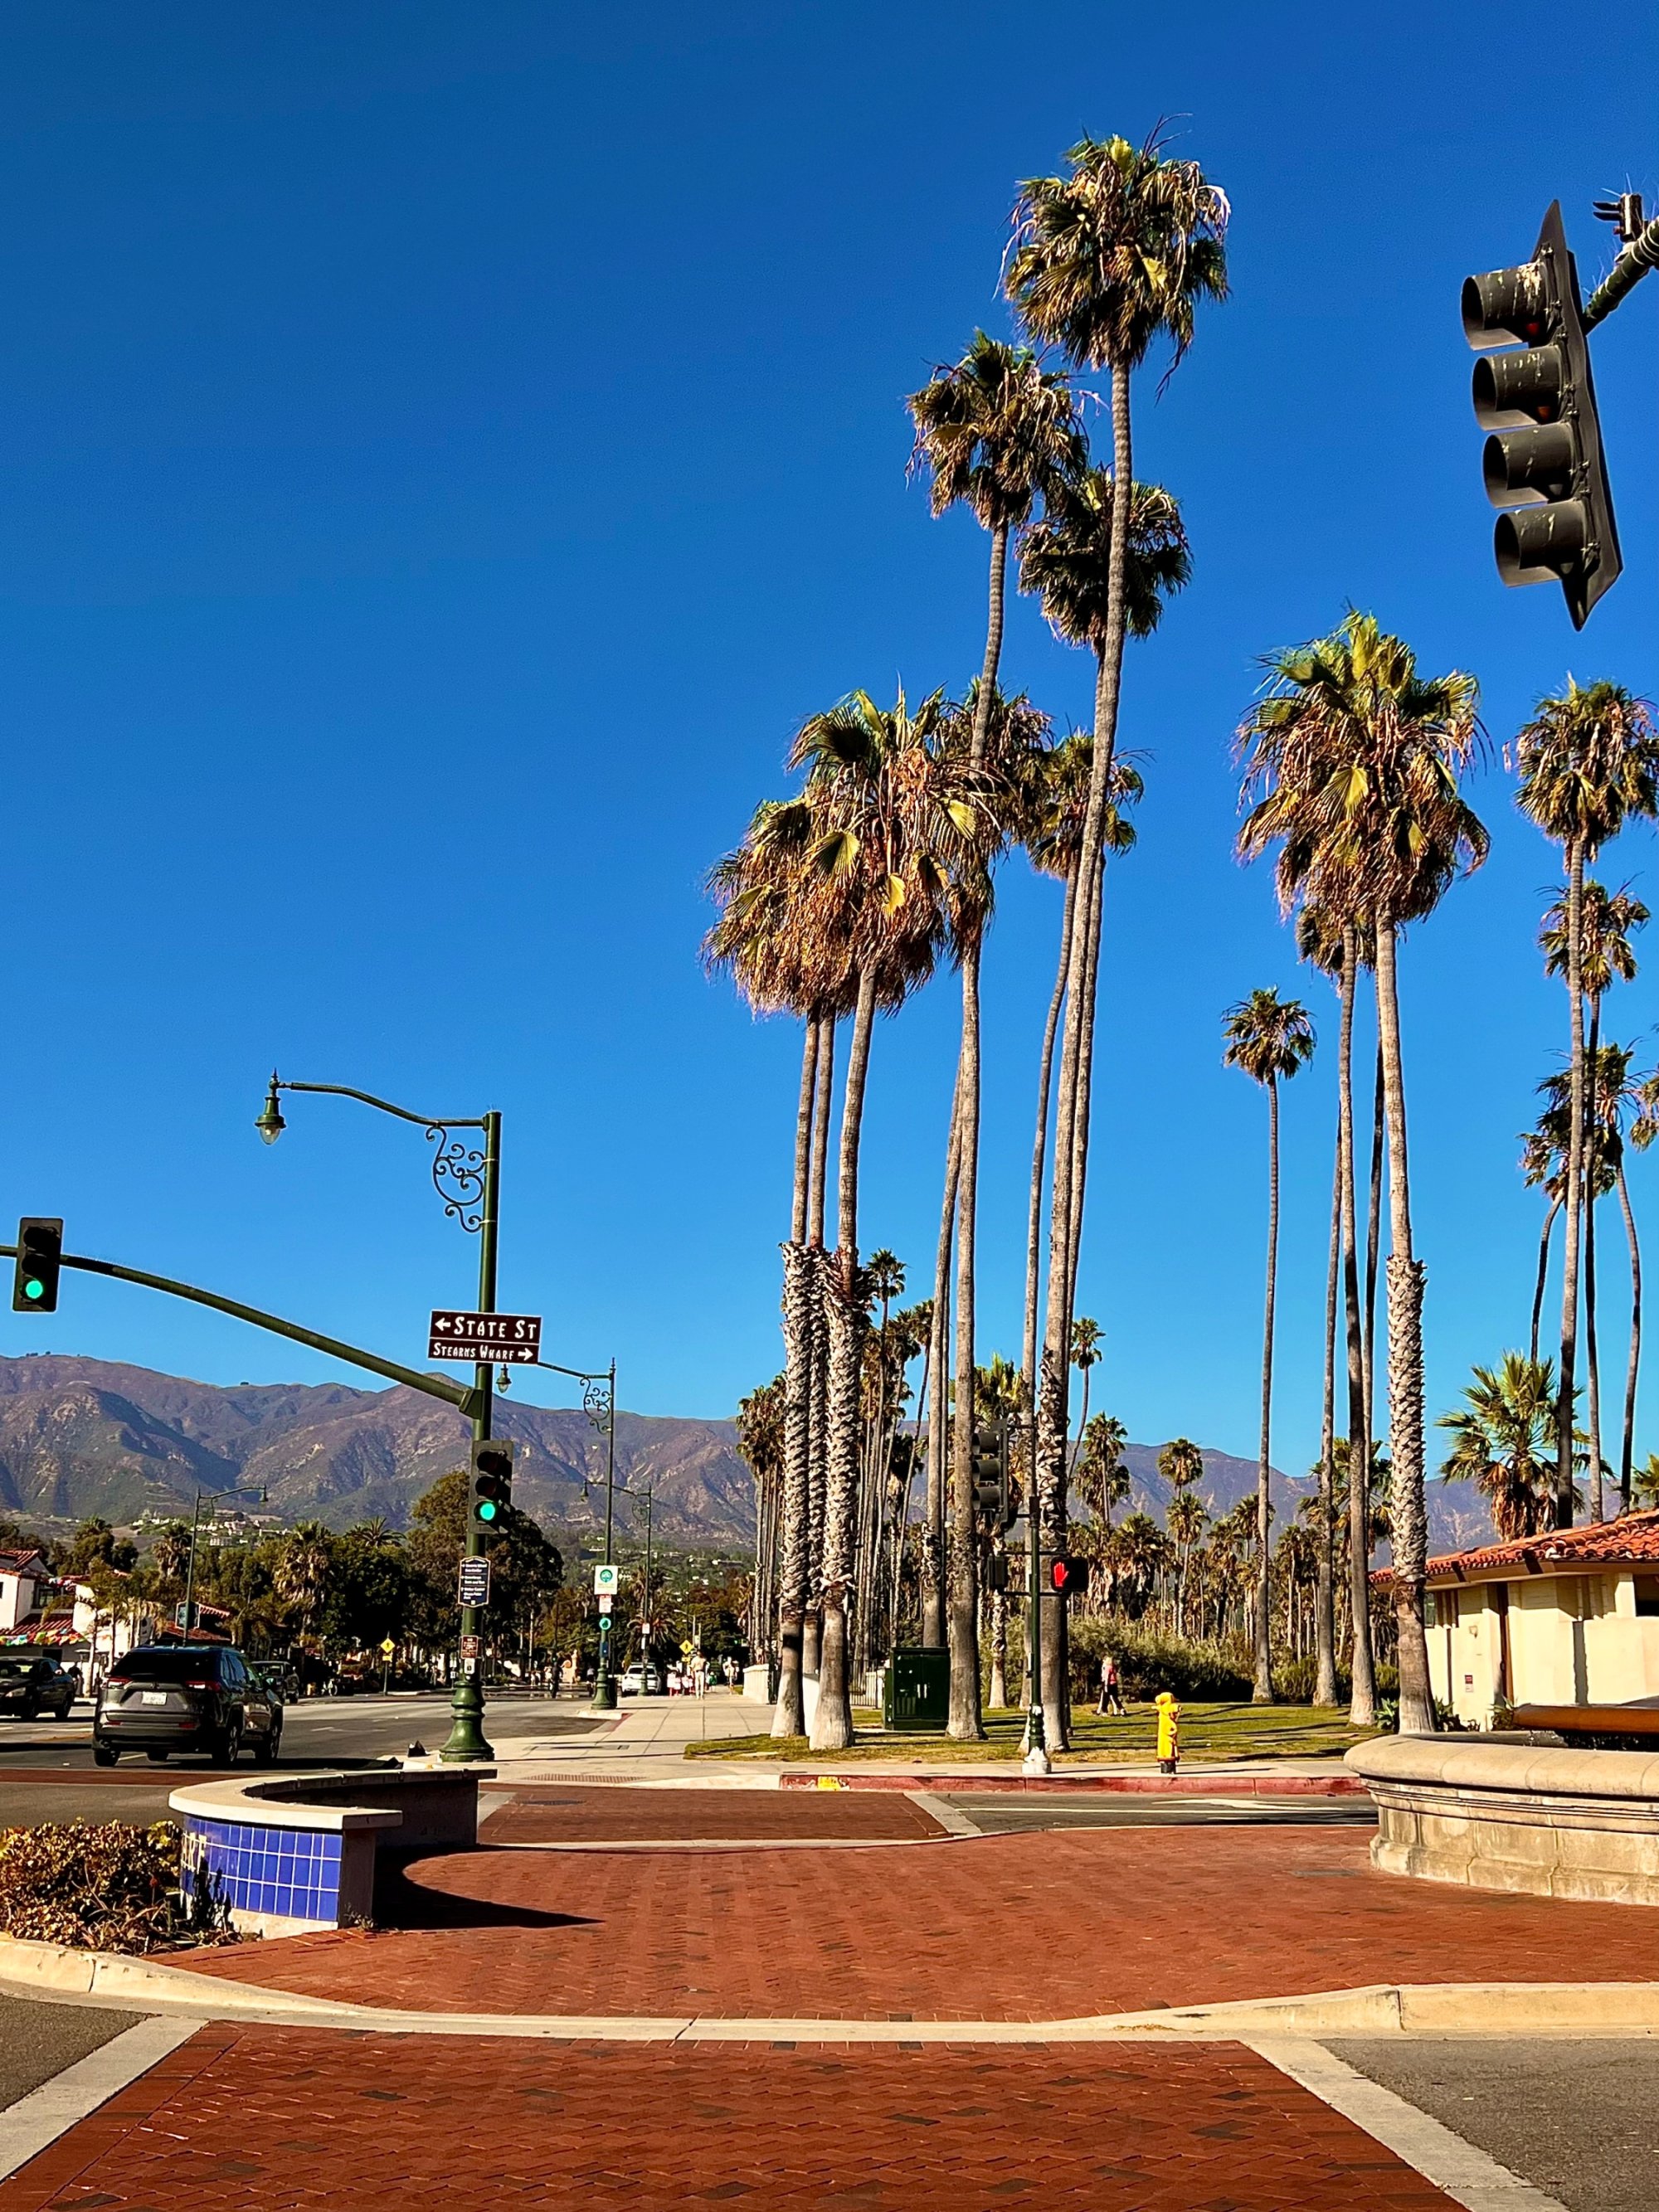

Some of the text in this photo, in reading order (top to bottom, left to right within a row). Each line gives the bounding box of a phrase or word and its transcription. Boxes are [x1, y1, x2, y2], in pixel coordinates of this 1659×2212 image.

[453, 1316, 537, 1339] STATE ST
[433, 1342, 514, 1360] STEARNS WHARF
